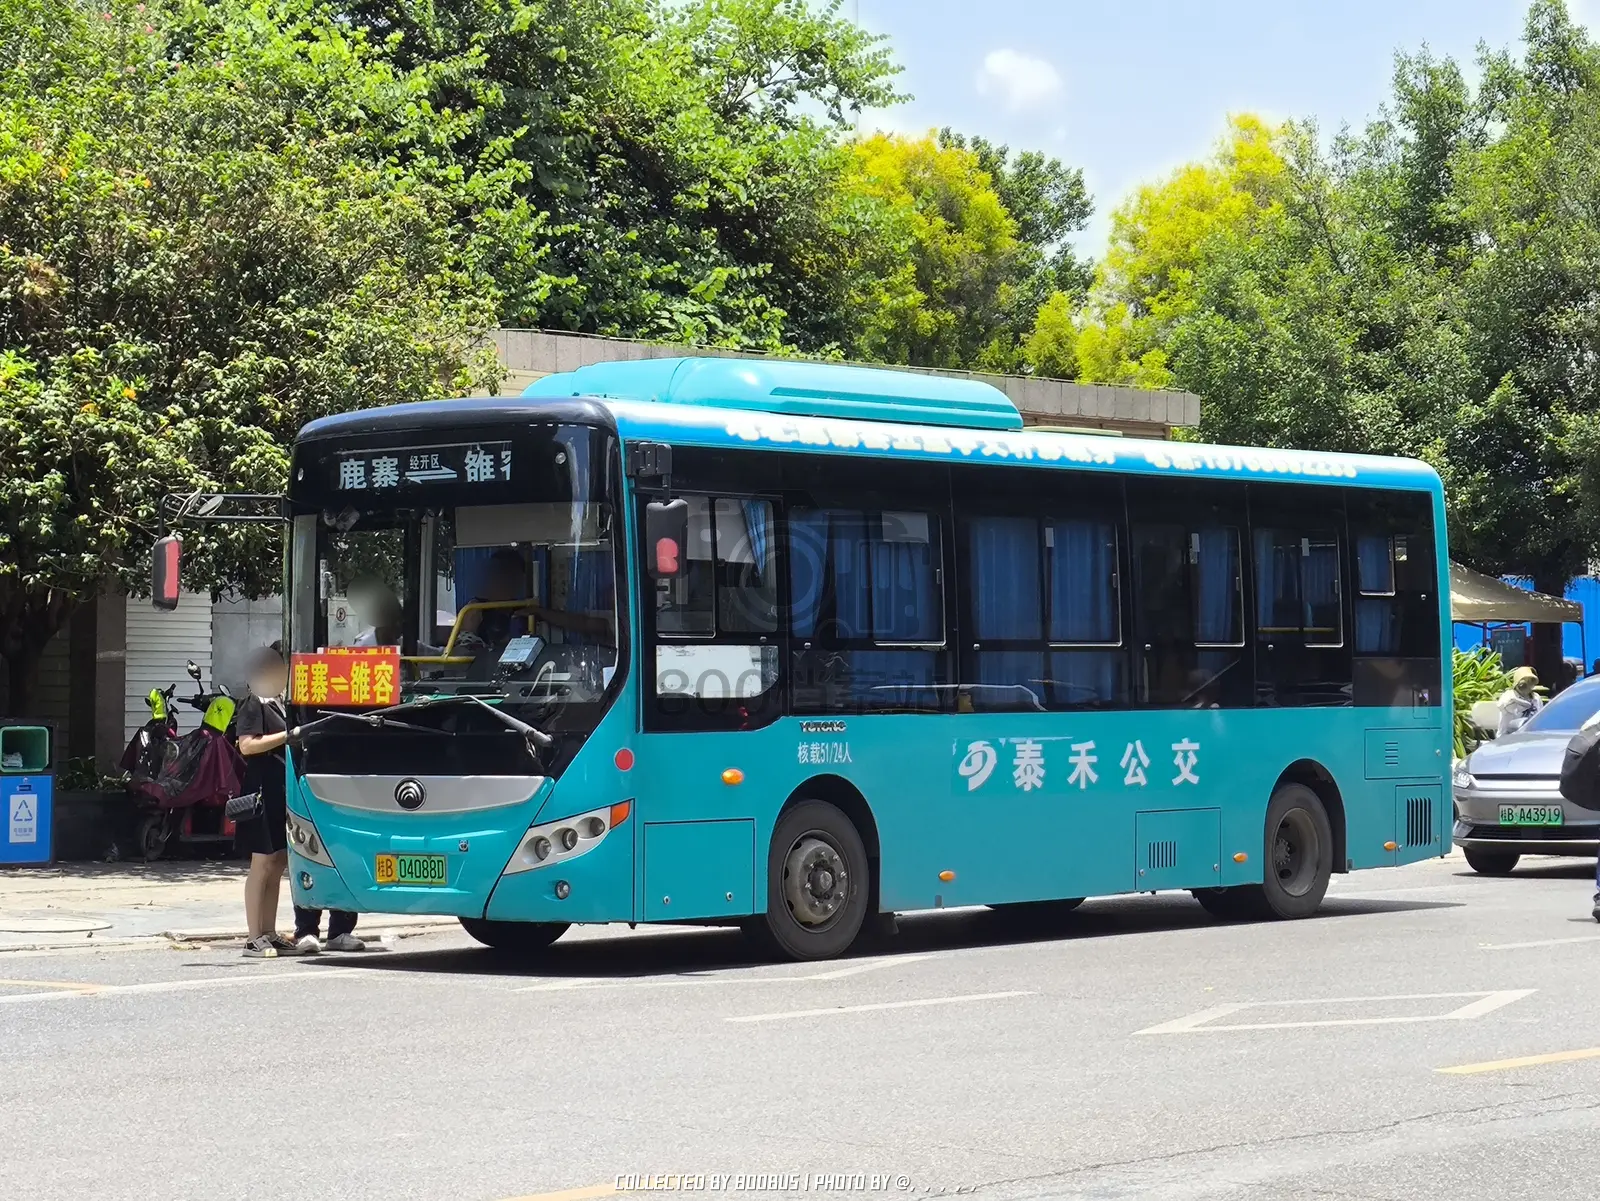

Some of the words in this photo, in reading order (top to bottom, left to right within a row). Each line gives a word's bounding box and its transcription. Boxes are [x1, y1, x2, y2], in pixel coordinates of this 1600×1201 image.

[338, 455, 400, 490] 鹿寨
[410, 453, 440, 470] 经开区
[294, 660, 329, 703] 鹿寨
[350, 660, 395, 704] 雒容
[797, 741, 852, 764] 核载51/24人
[1012, 737, 1200, 792] 泰禾公交
